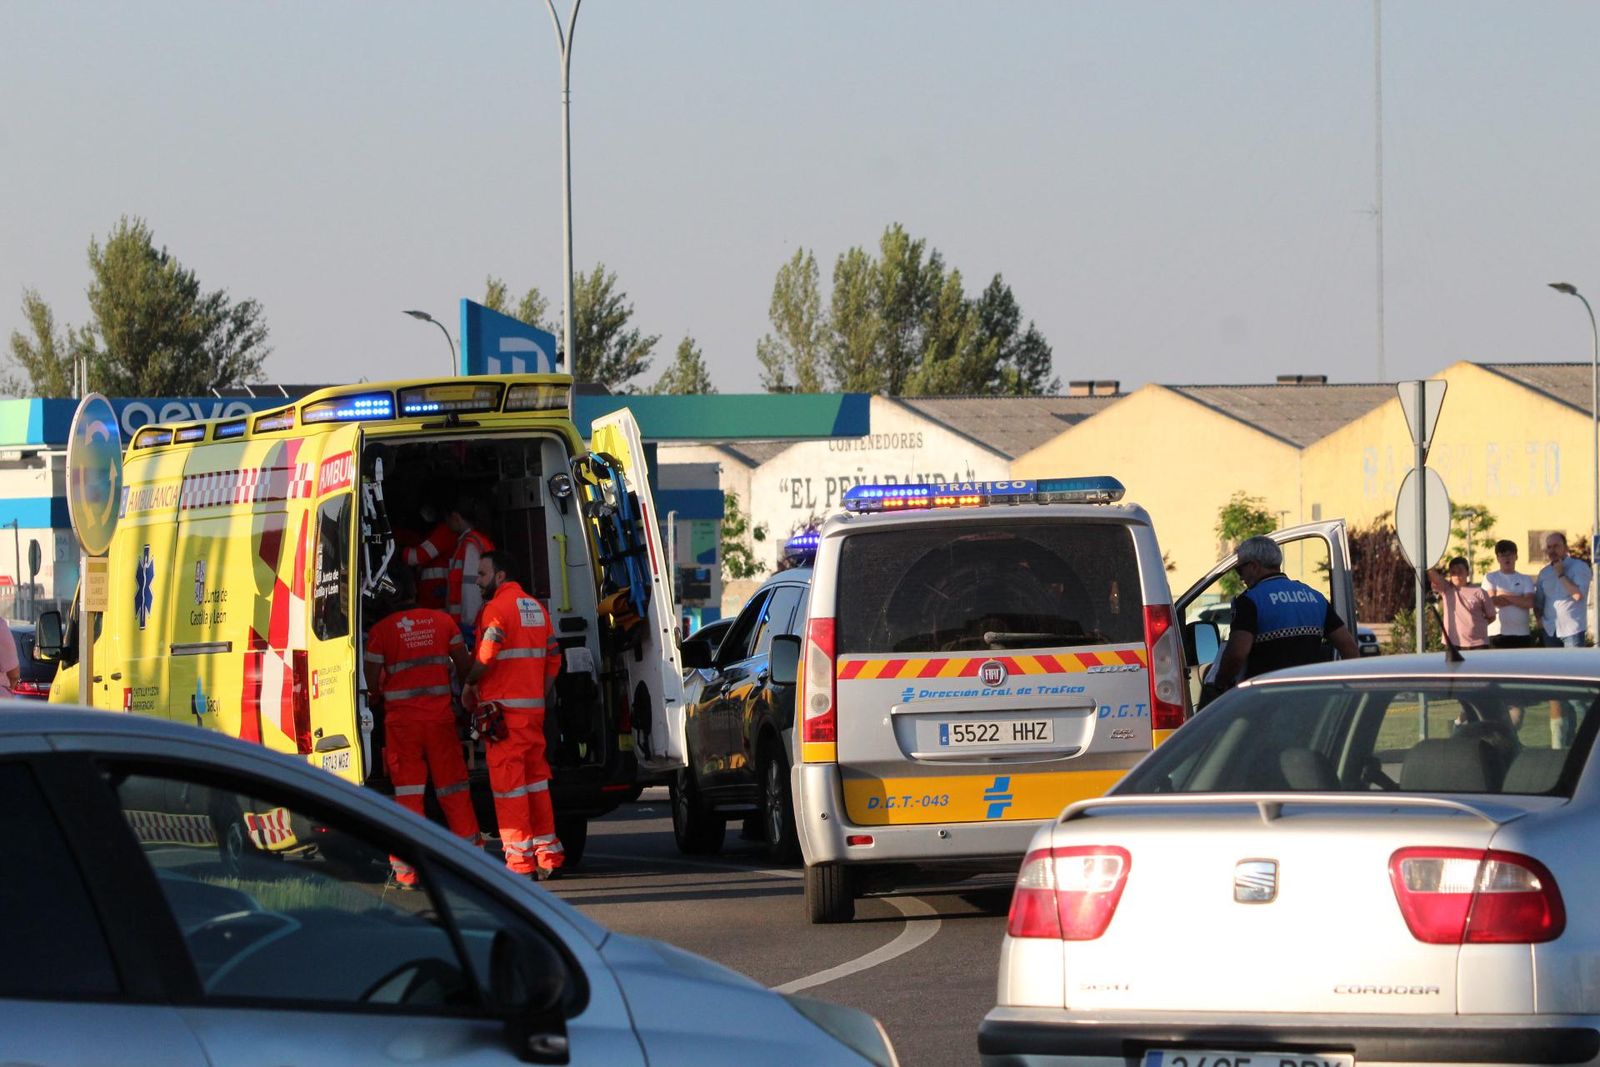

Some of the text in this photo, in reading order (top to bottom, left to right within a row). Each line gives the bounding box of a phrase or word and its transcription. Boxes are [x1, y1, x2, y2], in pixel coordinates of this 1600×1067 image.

[937, 479, 1027, 492] TRAFICO
[129, 485, 179, 512] AMBULANCIA
[1268, 587, 1319, 605] POLICÍA
[1016, 686, 1032, 695] de
[1099, 703, 1148, 719] D.G.T.
[953, 722, 1048, 743] 5522 HHZ
[1333, 984, 1440, 995] CORDOBA
